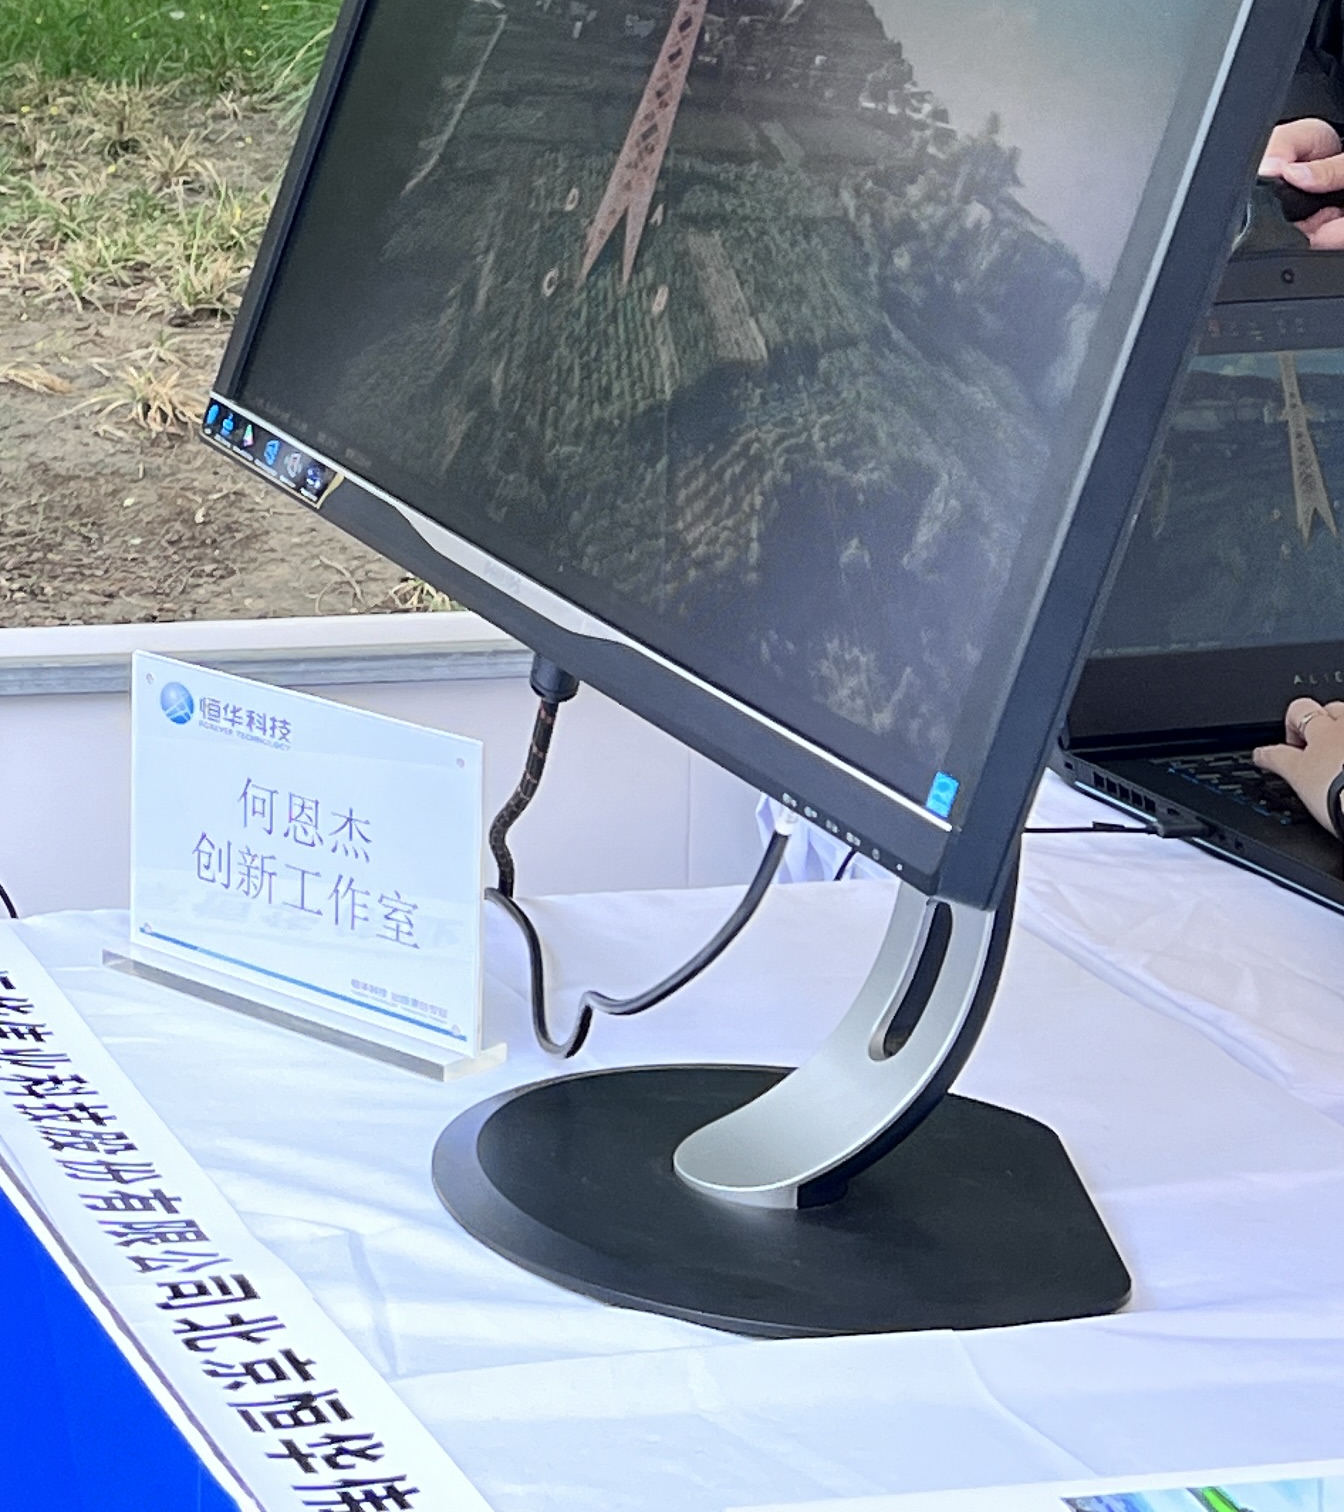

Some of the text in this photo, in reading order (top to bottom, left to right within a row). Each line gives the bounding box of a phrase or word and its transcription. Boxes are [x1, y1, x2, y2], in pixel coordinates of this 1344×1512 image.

[199, 697, 292, 744] 恒华科技
[237, 777, 373, 863] 何恩杰
[191, 831, 421, 950] 创新工作室
